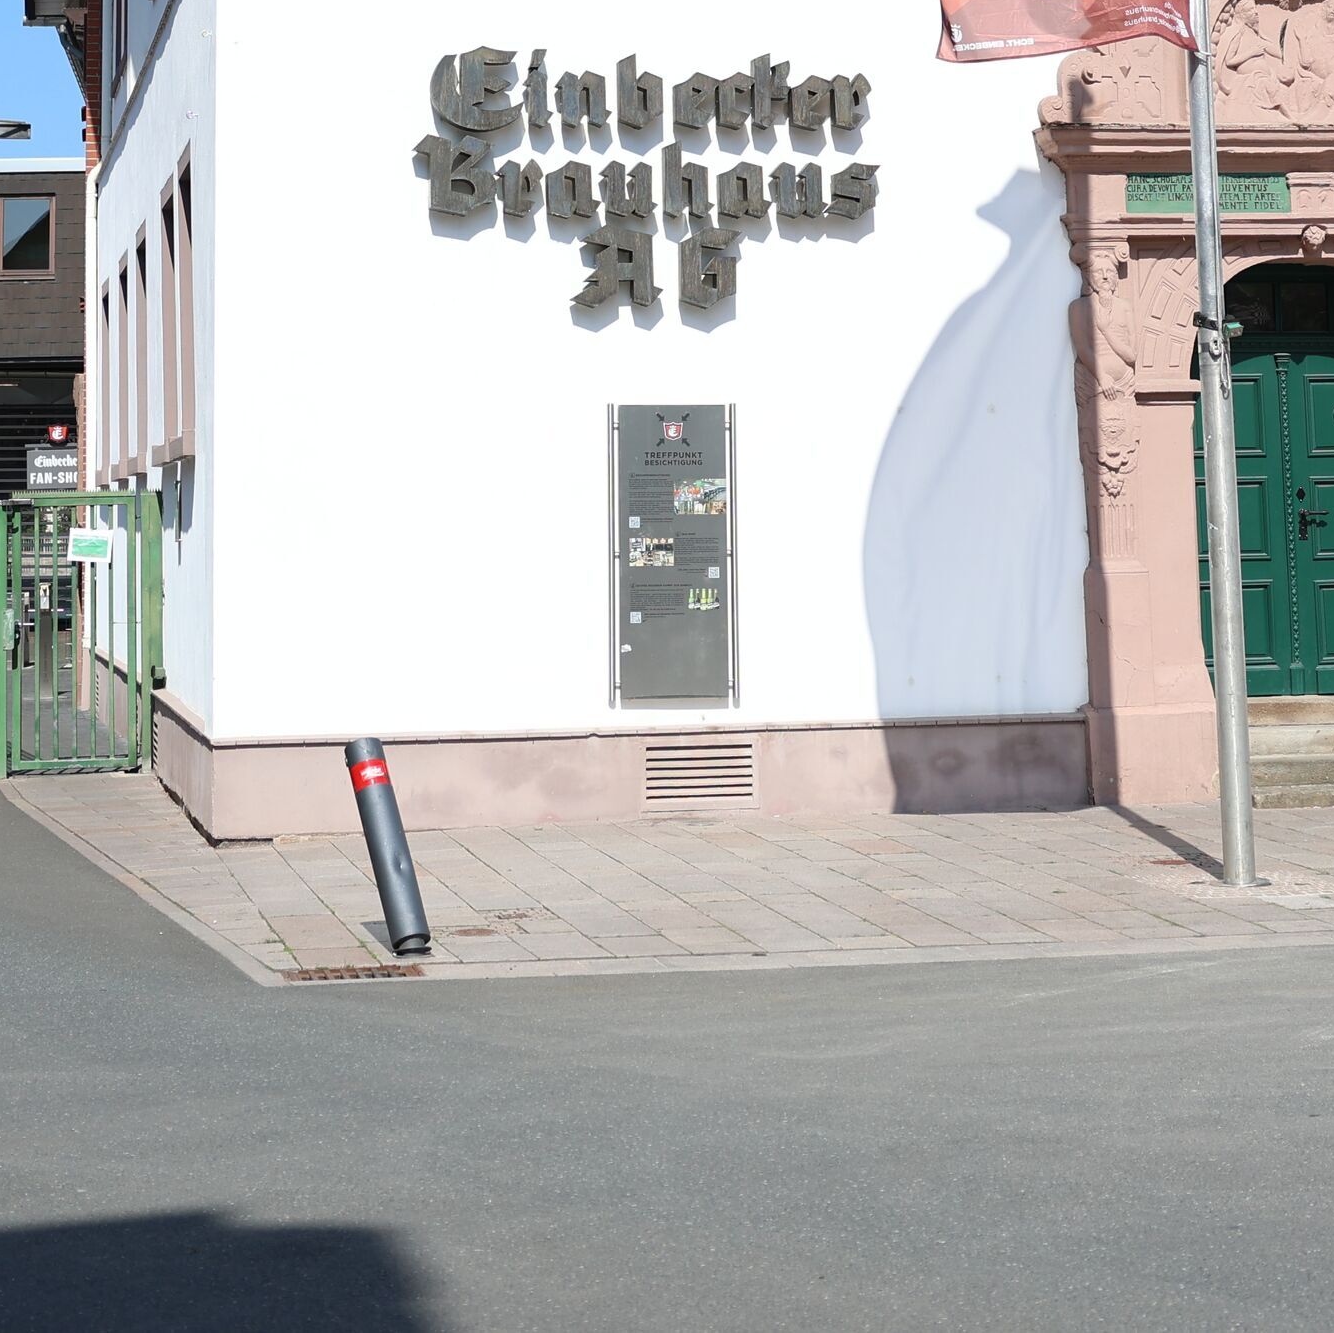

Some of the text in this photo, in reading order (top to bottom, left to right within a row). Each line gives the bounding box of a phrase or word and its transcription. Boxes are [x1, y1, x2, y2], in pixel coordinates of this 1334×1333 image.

[430, 46, 872, 132] Einbecker
[412, 134, 881, 220] Brauhaus
[1126, 184, 1148, 193] CURA
[570, 224, 743, 309] AG
[34, 454, 78, 468] Einbecke
[644, 451, 703, 459] TREFFPUNKT
